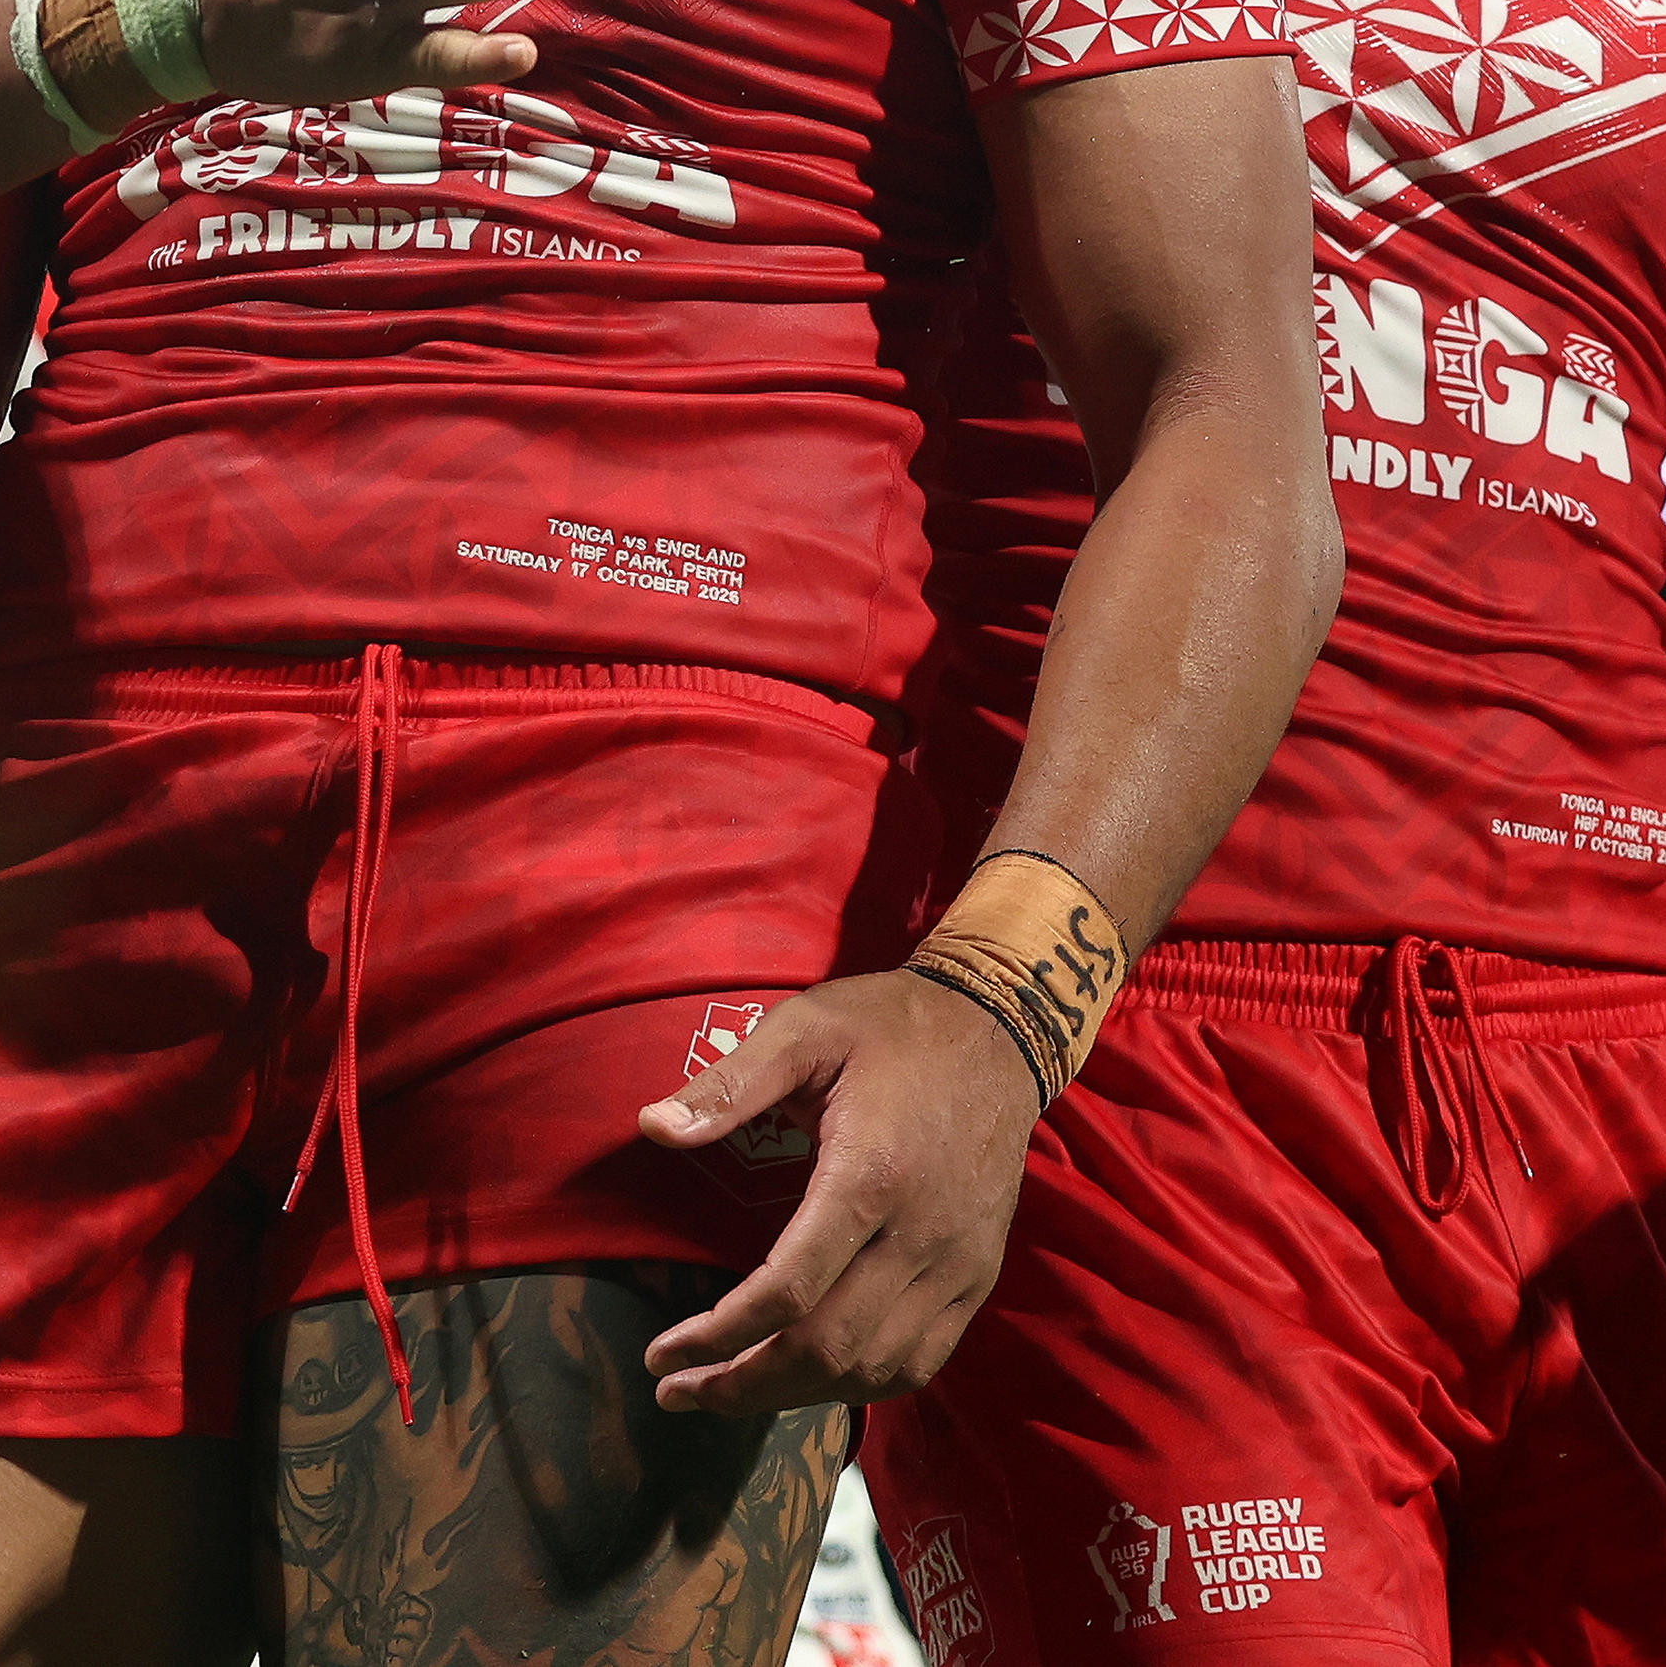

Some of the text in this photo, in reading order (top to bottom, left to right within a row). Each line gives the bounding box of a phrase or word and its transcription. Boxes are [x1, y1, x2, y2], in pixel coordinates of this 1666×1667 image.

[147, 205, 642, 272] THE FRIENDLY ISLANDS
[1312, 272, 1632, 485] NGA
[1324, 435, 1598, 529] NDLY ISLANDS
[547, 518, 616, 546] TONGA
[654, 537, 747, 569] ENGLAND
[456, 540, 741, 606] SATURDAY 17 OCTOBER 2026
[570, 541, 744, 589] HBF PARK, PERTH
[1559, 792, 1606, 816] TONGA
[1490, 818, 1569, 847] SATURDAY
[1574, 833, 1587, 850] 17
[1590, 836, 1654, 862] OCTOBER
[1574, 814, 1600, 833] HBF
[1602, 819, 1643, 844] PARK,
[1180, 1496, 1302, 1532] RUGBY
[1110, 1539, 1152, 1566] AUS
[1186, 1525, 1327, 1559] LEAGUE
[1118, 1558, 1148, 1581] 26
[1192, 1553, 1324, 1586] WORLD
[1199, 1582, 1272, 1615] CUP
[1133, 1612, 1158, 1630] IRL
